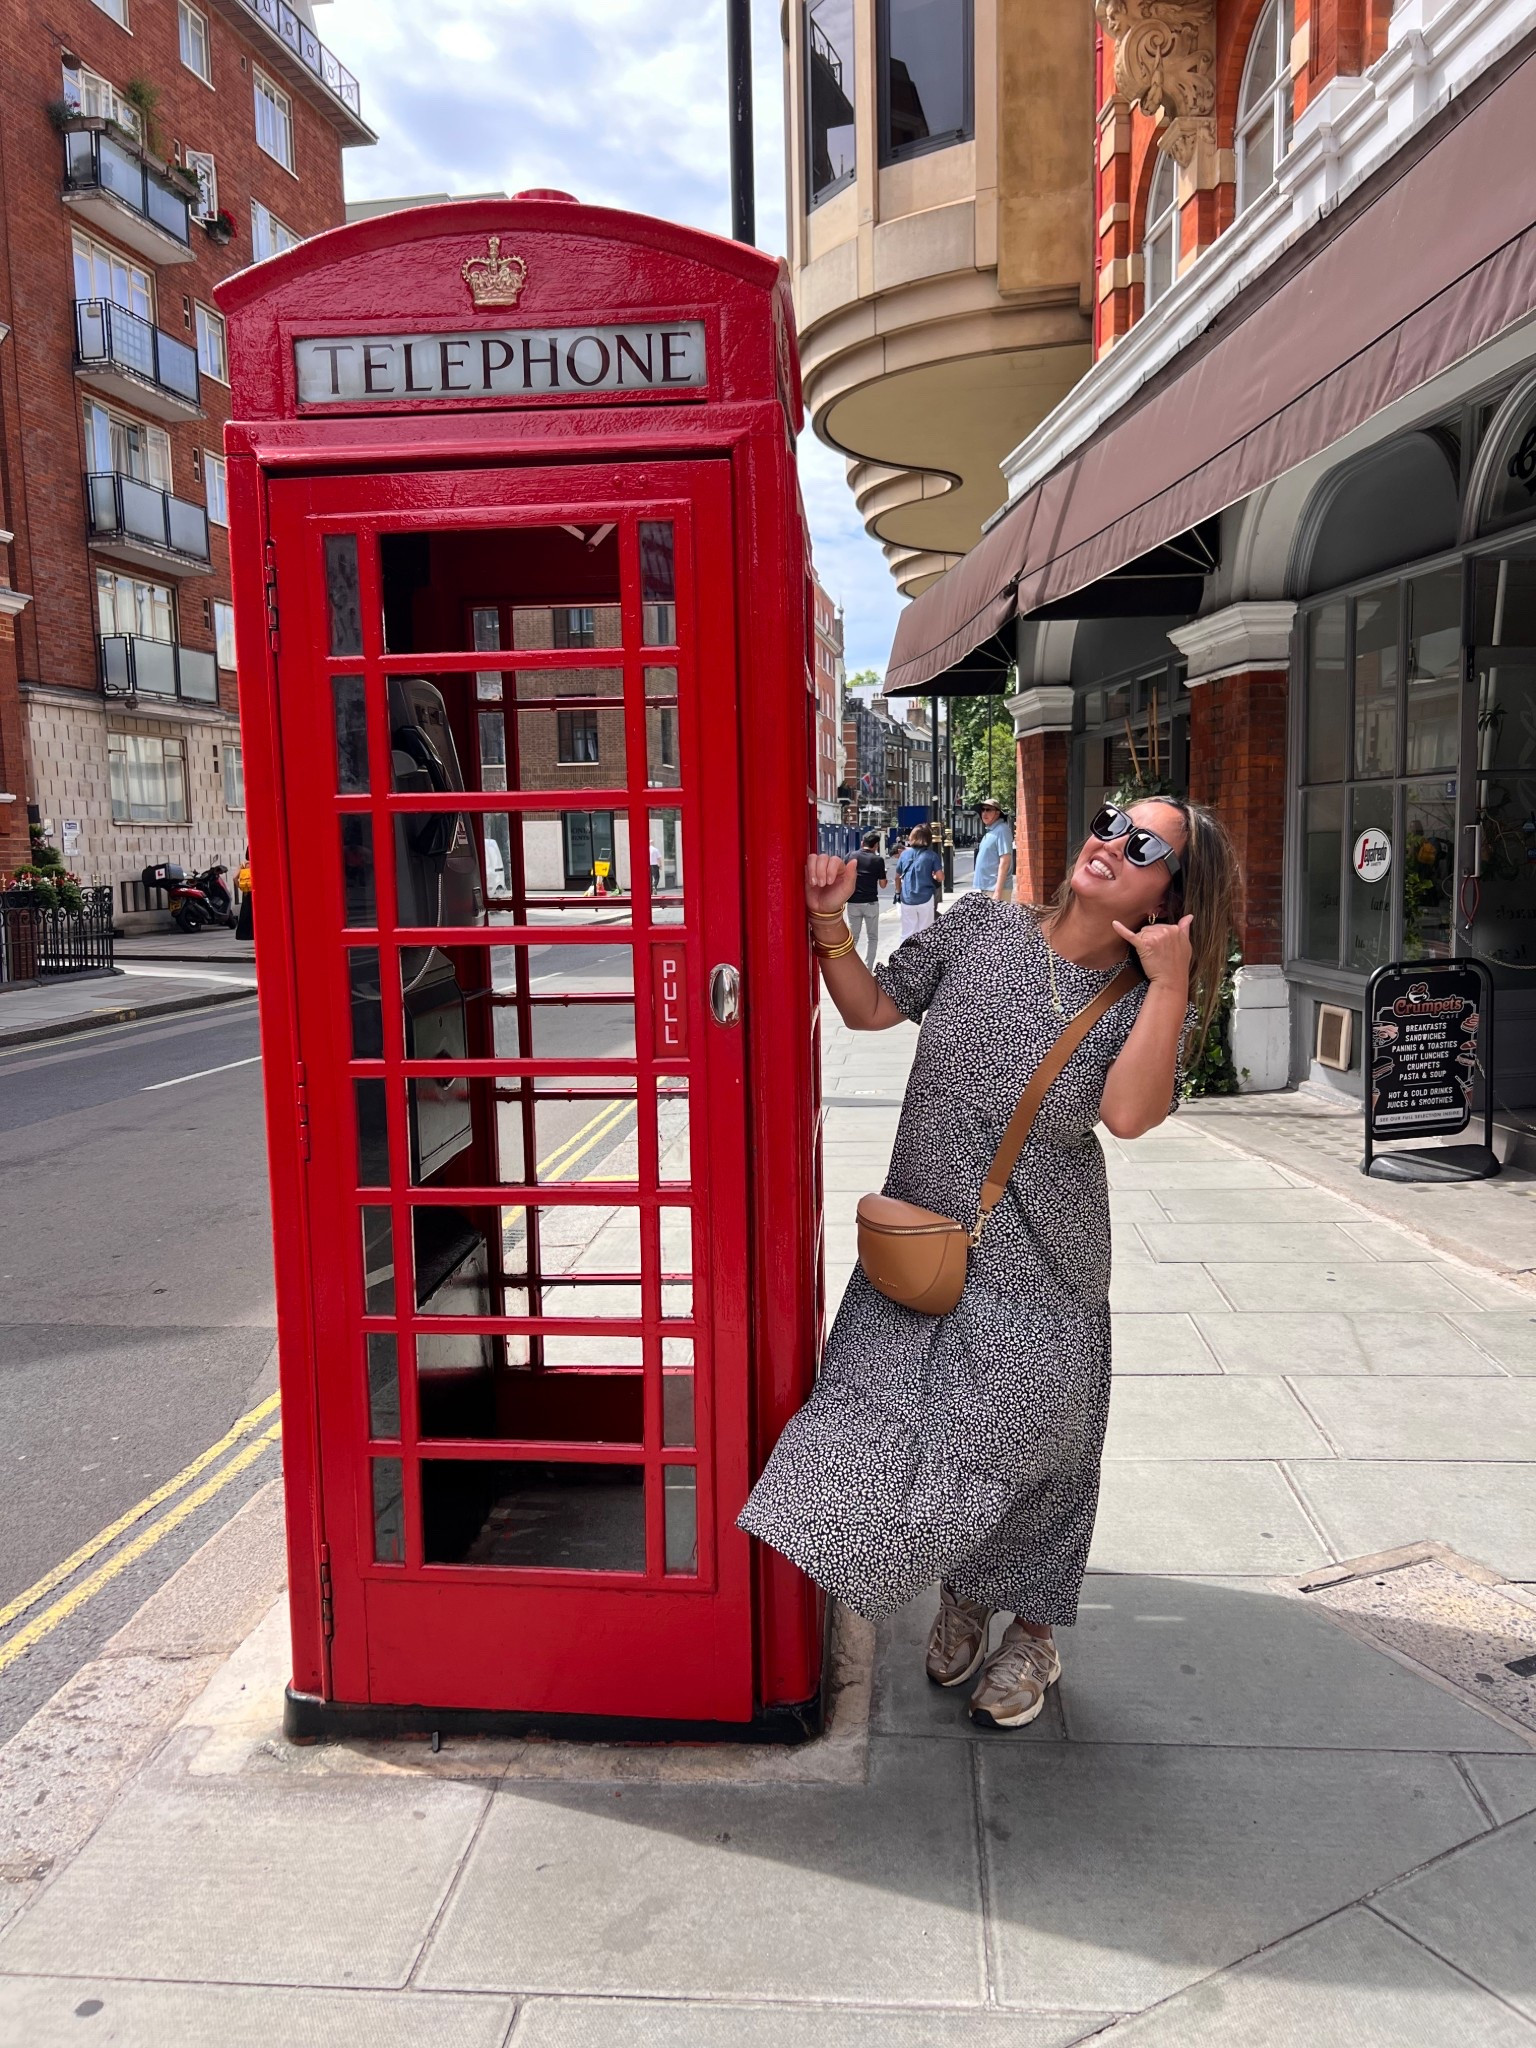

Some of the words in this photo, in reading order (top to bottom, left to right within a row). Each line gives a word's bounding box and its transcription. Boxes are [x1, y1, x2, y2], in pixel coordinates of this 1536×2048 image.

[311, 331, 694, 395] TELEPHONE
[662, 959, 679, 1044] PULL
[1395, 996, 1462, 1015] Crumpets
[1405, 1022, 1447, 1033] BREAKFASTS
[1405, 1032, 1446, 1042] SANDWICHES
[1391, 1044, 1417, 1053] PANINIS
[1419, 1043, 1425, 1051] &
[1427, 1041, 1458, 1050] TOASTIES
[1399, 1053, 1418, 1062] LIGHT
[1420, 1051, 1449, 1060] LUNCHES
[1407, 1061, 1440, 1071] CRUMPETS
[1399, 1073, 1419, 1081] PASTA
[1429, 1070, 1447, 1078] SOUP
[1388, 1091, 1401, 1099] HOT
[1411, 1089, 1428, 1097] COLD
[1429, 1086, 1453, 1095] DRINKS
[1386, 1100, 1408, 1109] JUICES
[1410, 1099, 1416, 1107] &
[1418, 1096, 1453, 1106] SMOOTHIES
